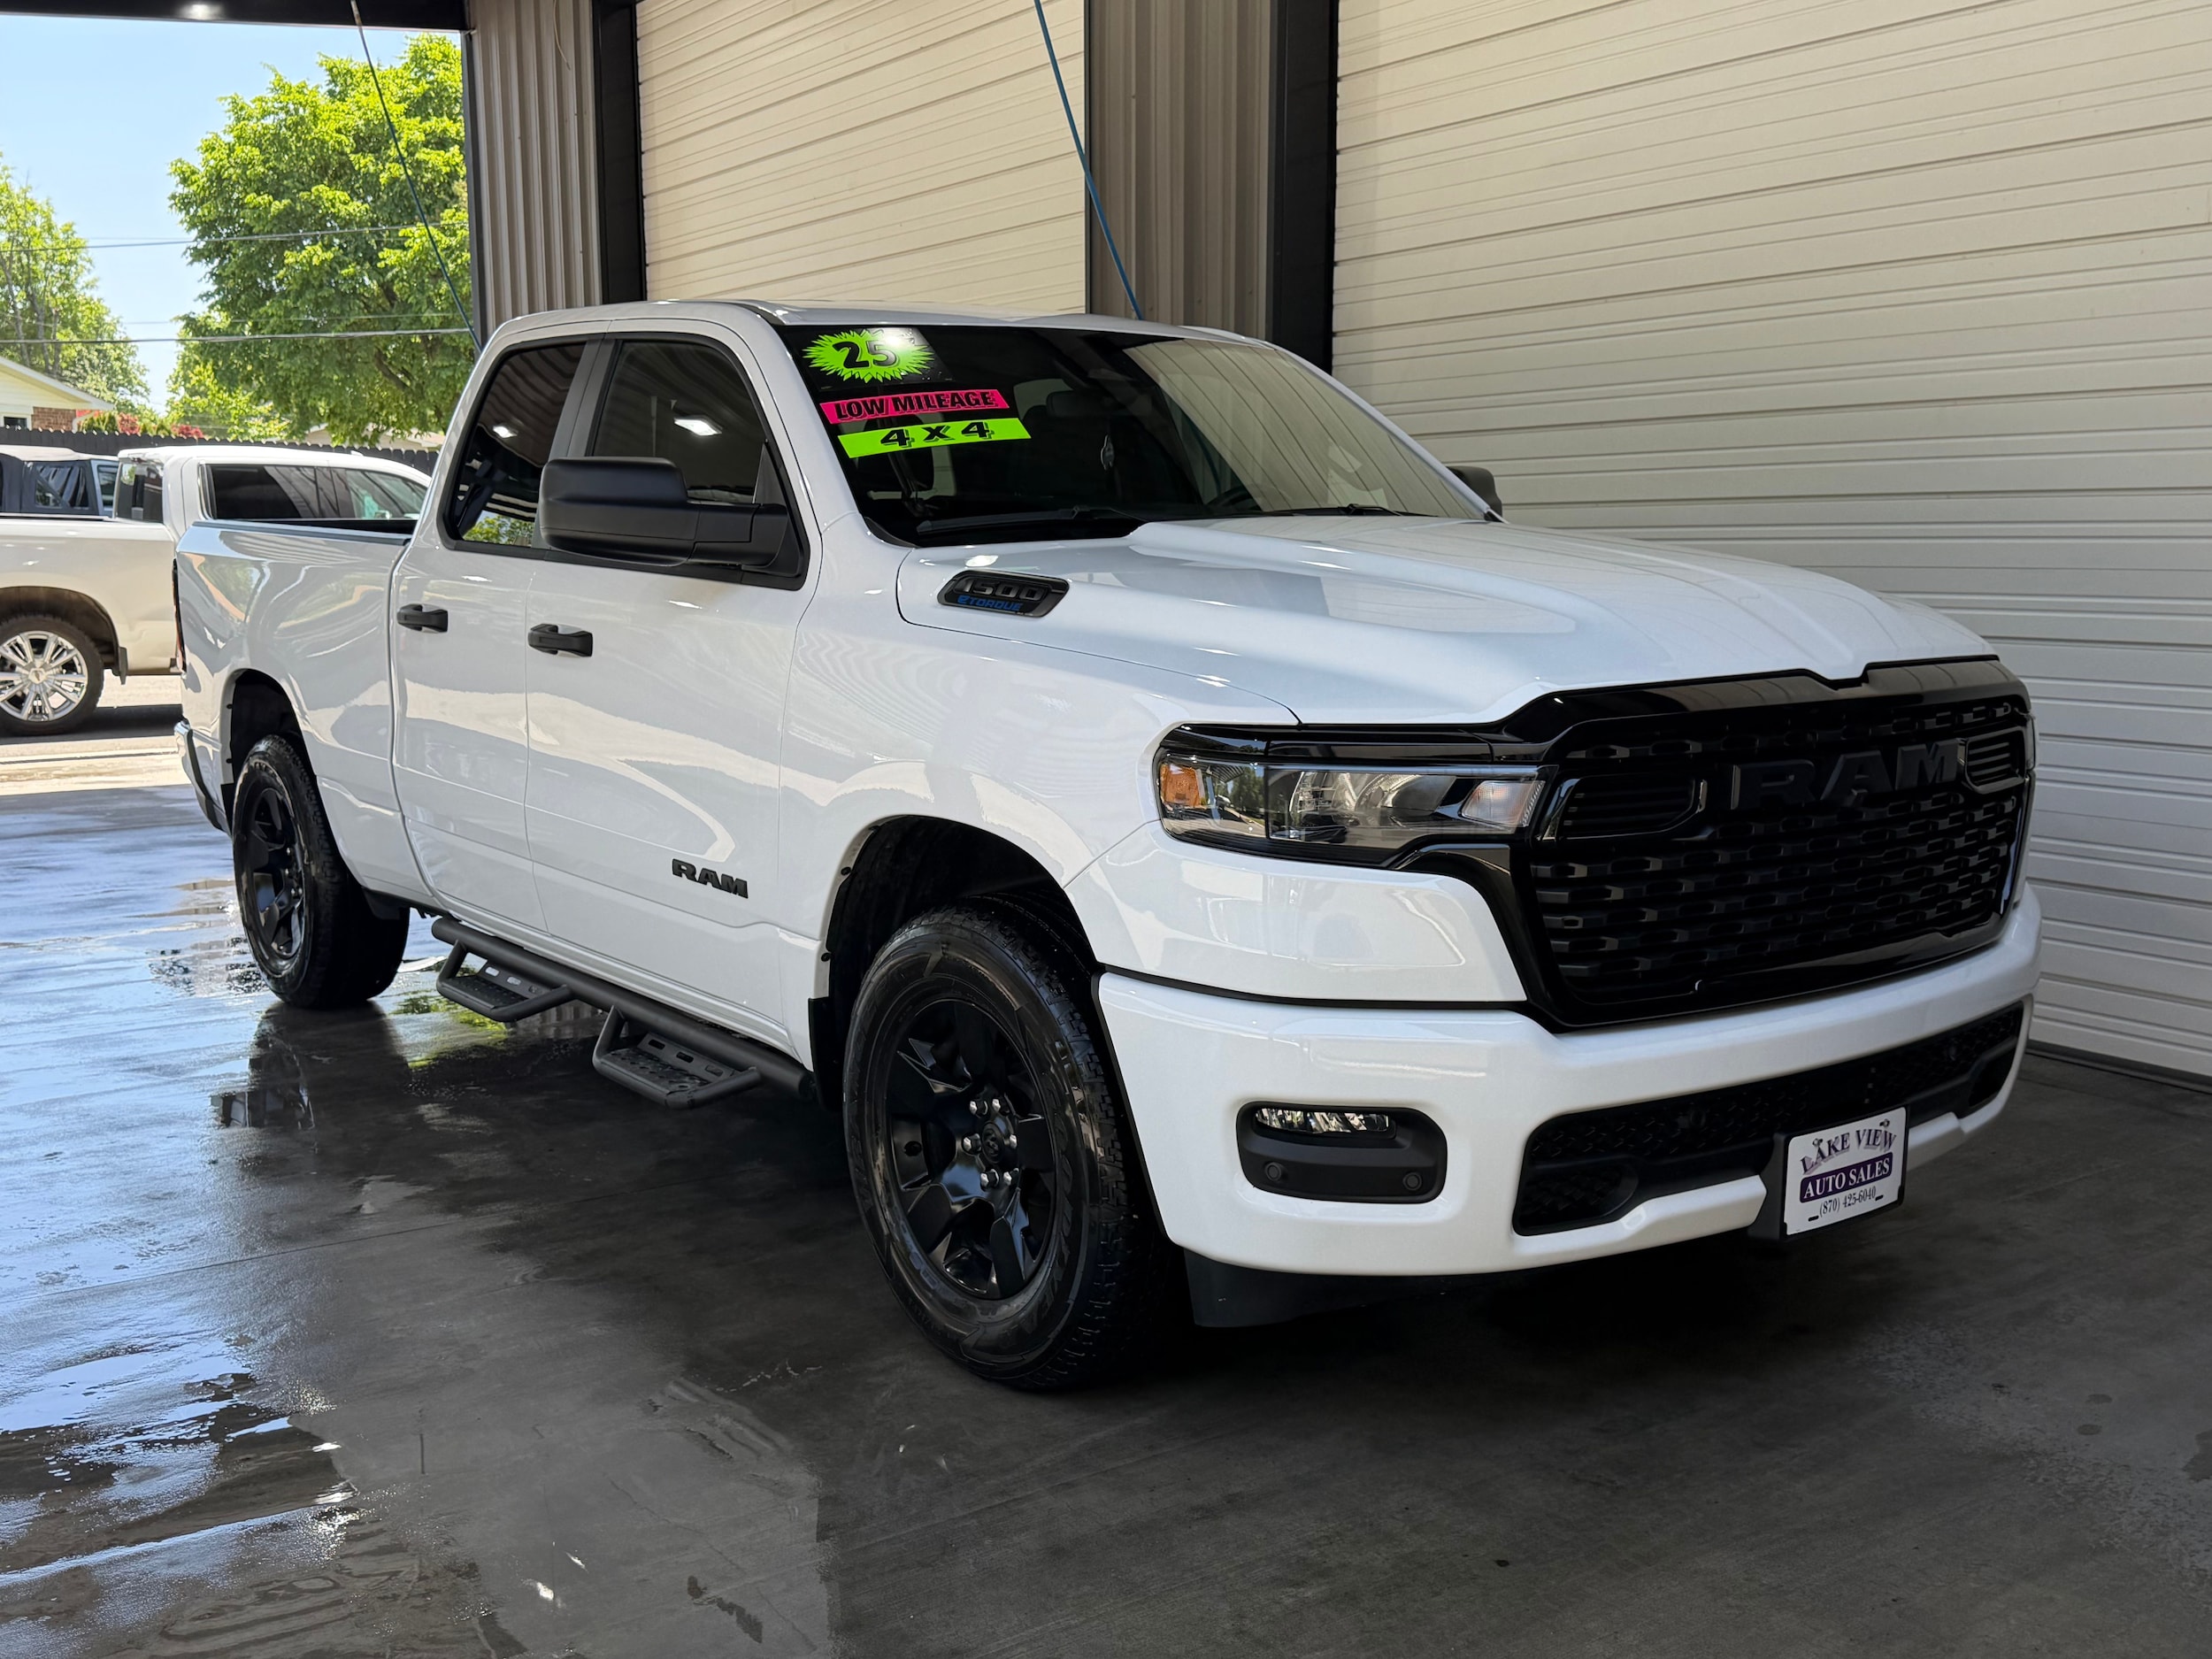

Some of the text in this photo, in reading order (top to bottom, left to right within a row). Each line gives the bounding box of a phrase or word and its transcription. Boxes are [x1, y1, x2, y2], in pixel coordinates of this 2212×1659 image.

[833, 341, 898, 368] 25
[834, 391, 998, 420] LOW MILEAGE
[955, 579, 1047, 601] 1500
[1731, 738, 1966, 810] RAM
[672, 858, 749, 899] RAM
[1800, 1128, 1896, 1173] LAKE VIEW
[1803, 1157, 1890, 1199] AUTO SALES
[1819, 1186, 1877, 1217] (870) 425-6040
